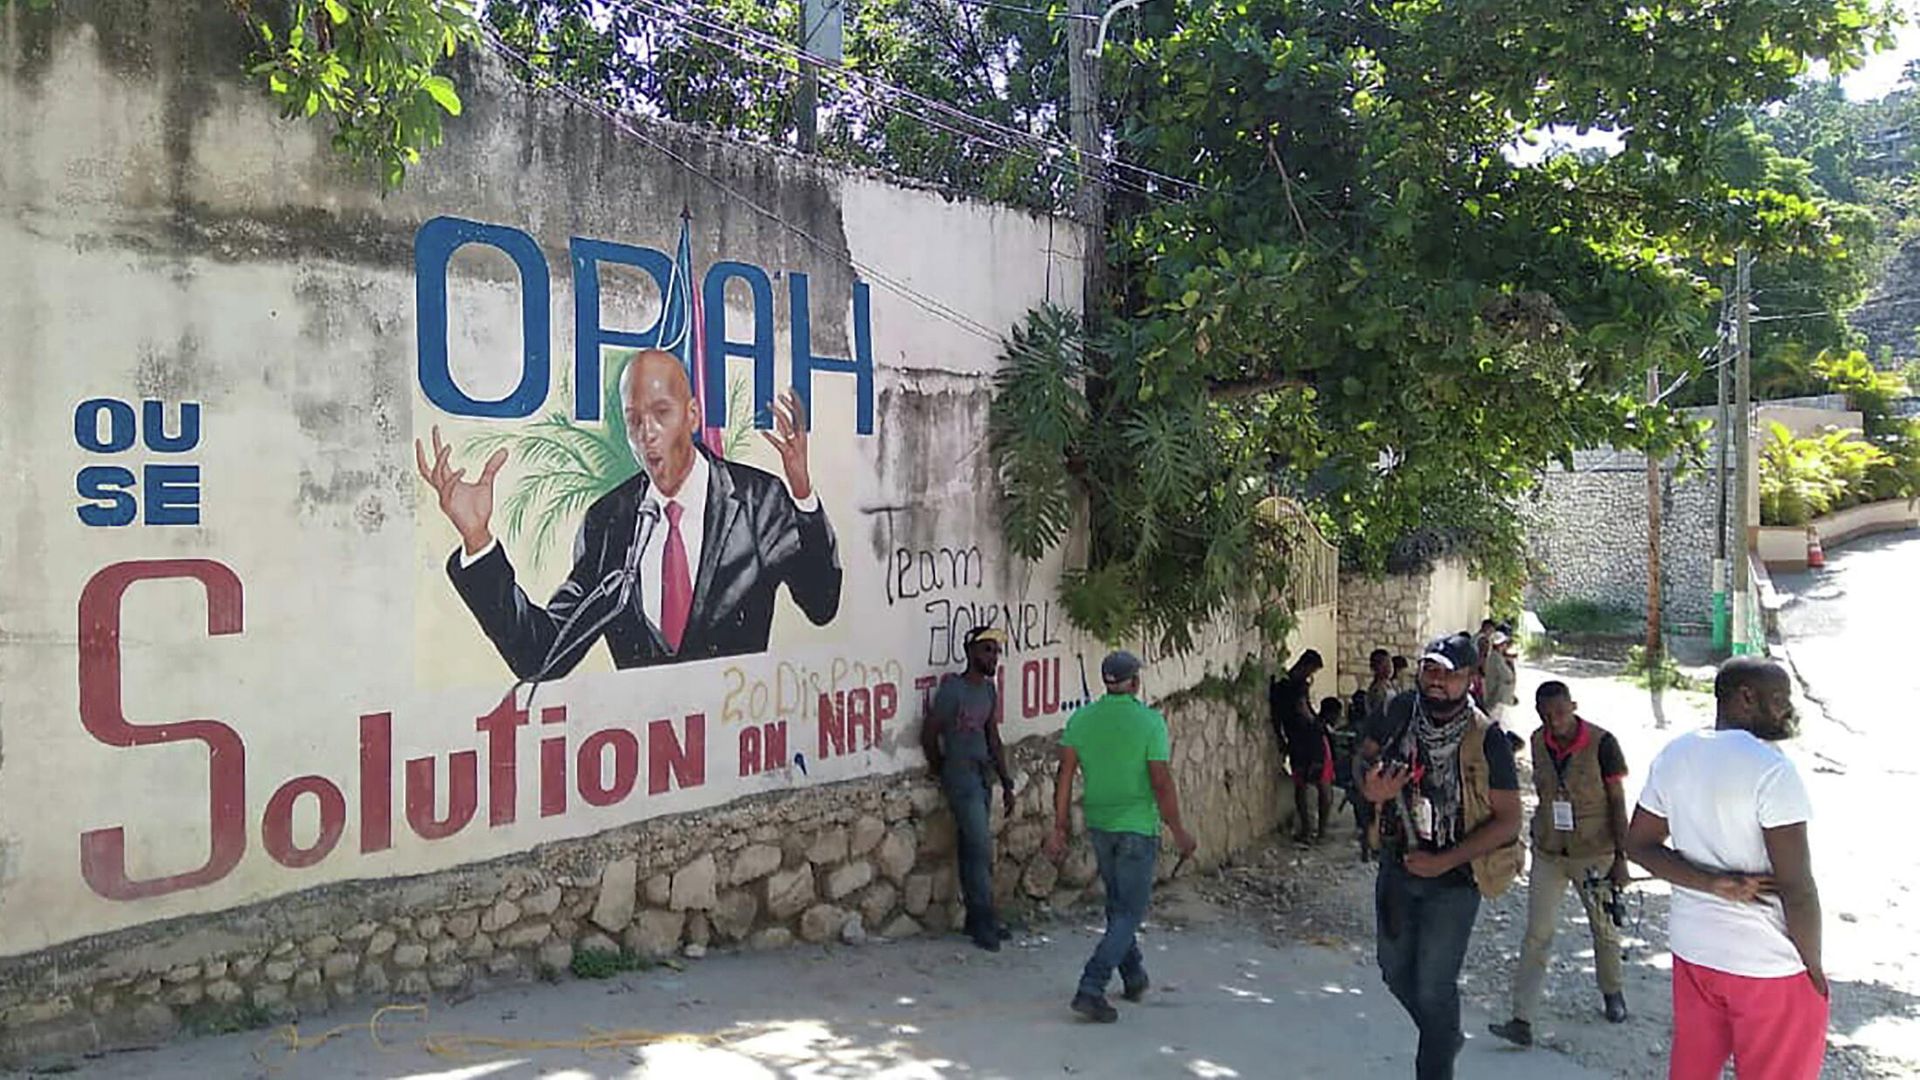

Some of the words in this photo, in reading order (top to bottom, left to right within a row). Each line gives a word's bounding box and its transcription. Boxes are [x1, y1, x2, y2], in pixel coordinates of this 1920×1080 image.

[414, 215, 874, 435] OPAH
[73, 398, 200, 453] OU
[76, 464, 200, 527] SE
[819, 682, 898, 760] NAP
